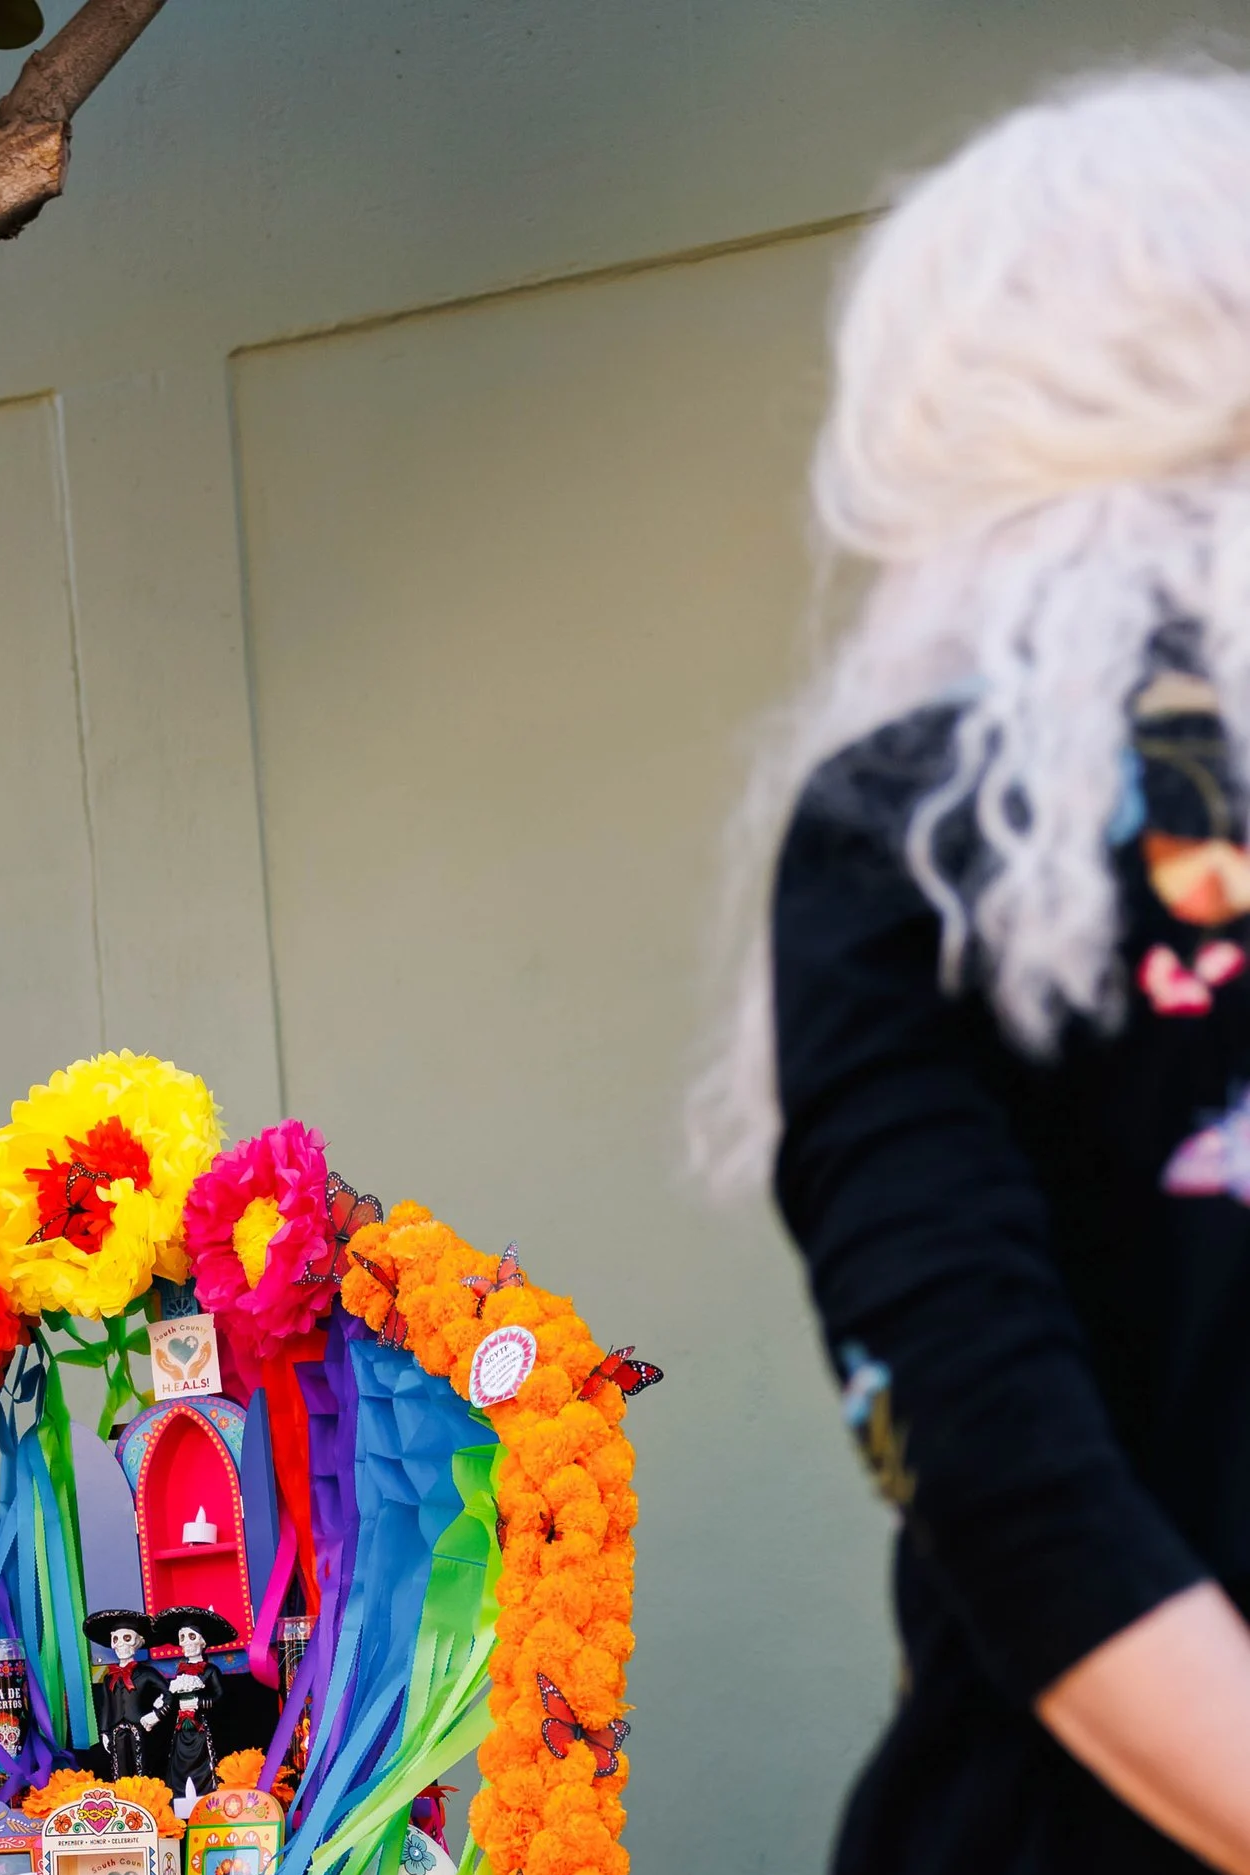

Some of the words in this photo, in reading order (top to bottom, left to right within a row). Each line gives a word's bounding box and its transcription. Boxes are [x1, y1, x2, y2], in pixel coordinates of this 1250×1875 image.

[154, 1326, 176, 1342] South
[180, 1324, 208, 1336] County
[485, 1344, 508, 1366] SCYTF
[162, 1378, 210, 1392] H.E.A.L.S!
[8, 1688, 20, 1699] DE
[91, 1859, 116, 1874] South
[120, 1858, 141, 1867] Coun
